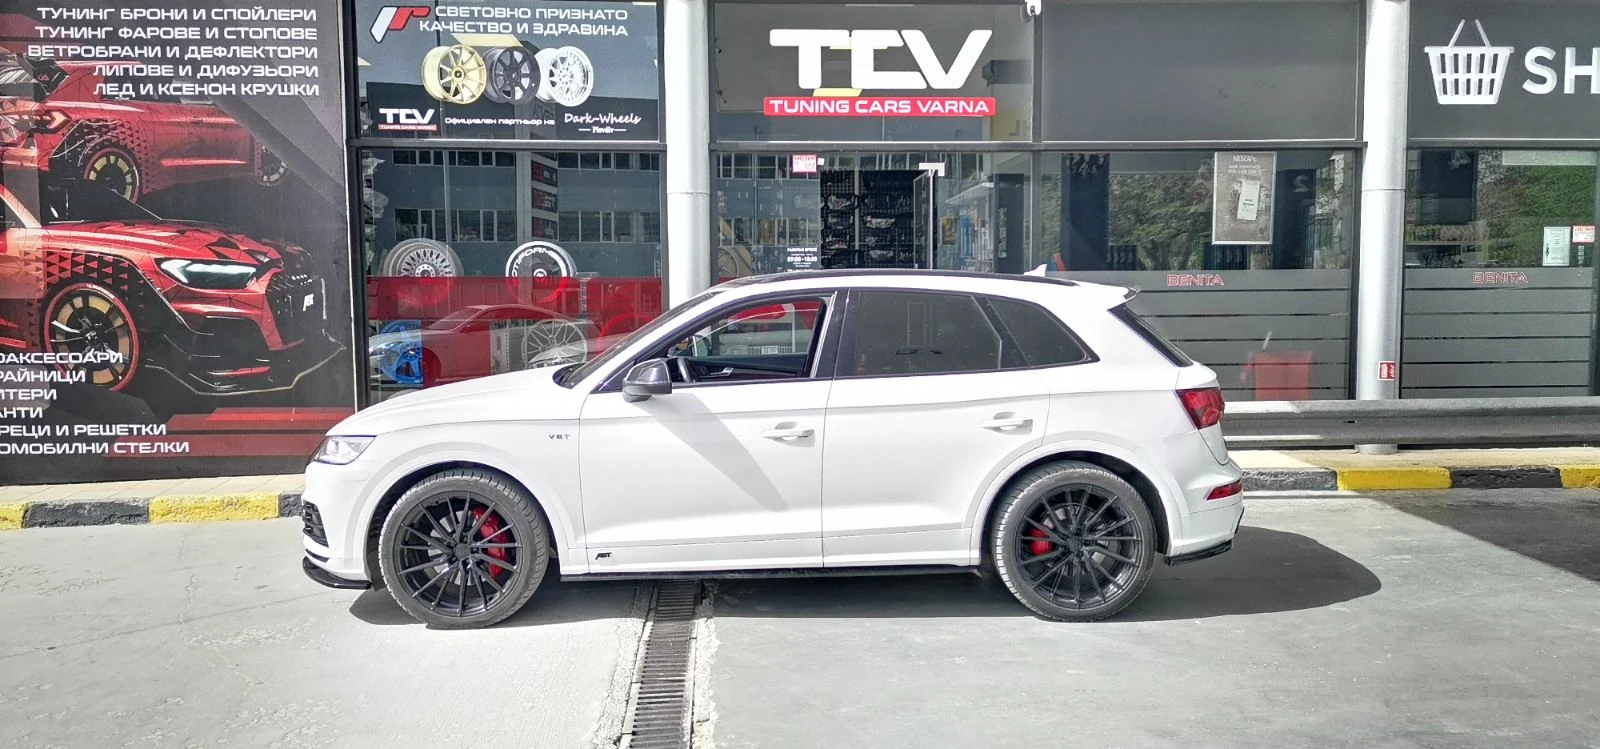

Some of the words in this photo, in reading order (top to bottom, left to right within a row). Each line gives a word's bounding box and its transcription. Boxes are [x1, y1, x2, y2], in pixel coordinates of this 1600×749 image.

[37, 8, 115, 20] ТУНИНГ
[120, 8, 187, 20] БРОНИ
[193, 9, 206, 20] И
[211, 6, 317, 21] СПОЙЛЕРИ
[435, 5, 532, 18] СВЕТОВНО
[535, 8, 628, 20] ПРИЗНАТО
[35, 26, 113, 39] ТУНИНГ
[118, 27, 201, 39] ФАРОВЕ
[206, 27, 219, 39] И
[224, 27, 318, 40] СТОПОВЕ
[419, 20, 513, 34] КАЧЕСТВО
[517, 23, 529, 34] И
[533, 22, 628, 36] ЗДРАВИНА
[28, 46, 161, 58] ВЕТРОБРАНИ
[166, 46, 179, 58] И
[185, 46, 318, 60] ДЕФЛЕКТОРИ
[770, 29, 992, 90] TCV
[93, 65, 174, 77] ЛИПОВЕ
[179, 65, 192, 77] И
[197, 65, 319, 79] ДИФУЗЬОРИ
[1522, 46, 1600, 94] SH
[93, 83, 136, 98] ЛЕД
[140, 84, 153, 95] И
[158, 83, 236, 95] КСЕНОН
[241, 83, 319, 96] КРУШКИ
[769, 100, 850, 113] TUNING
[855, 100, 911, 113] CARS
[917, 100, 989, 113] VARNA
[379, 108, 435, 124] TCV
[564, 113, 642, 124] Dark-Wheels
[1167, 273, 1224, 286] BENITA
[1472, 271, 1529, 284] BENITA
[0, 407, 43, 418] НТИ
[56, 425, 70, 436] И
[74, 424, 166, 436] РЕШЕТКИ
[114, 441, 190, 454] СТЕЛКИ
